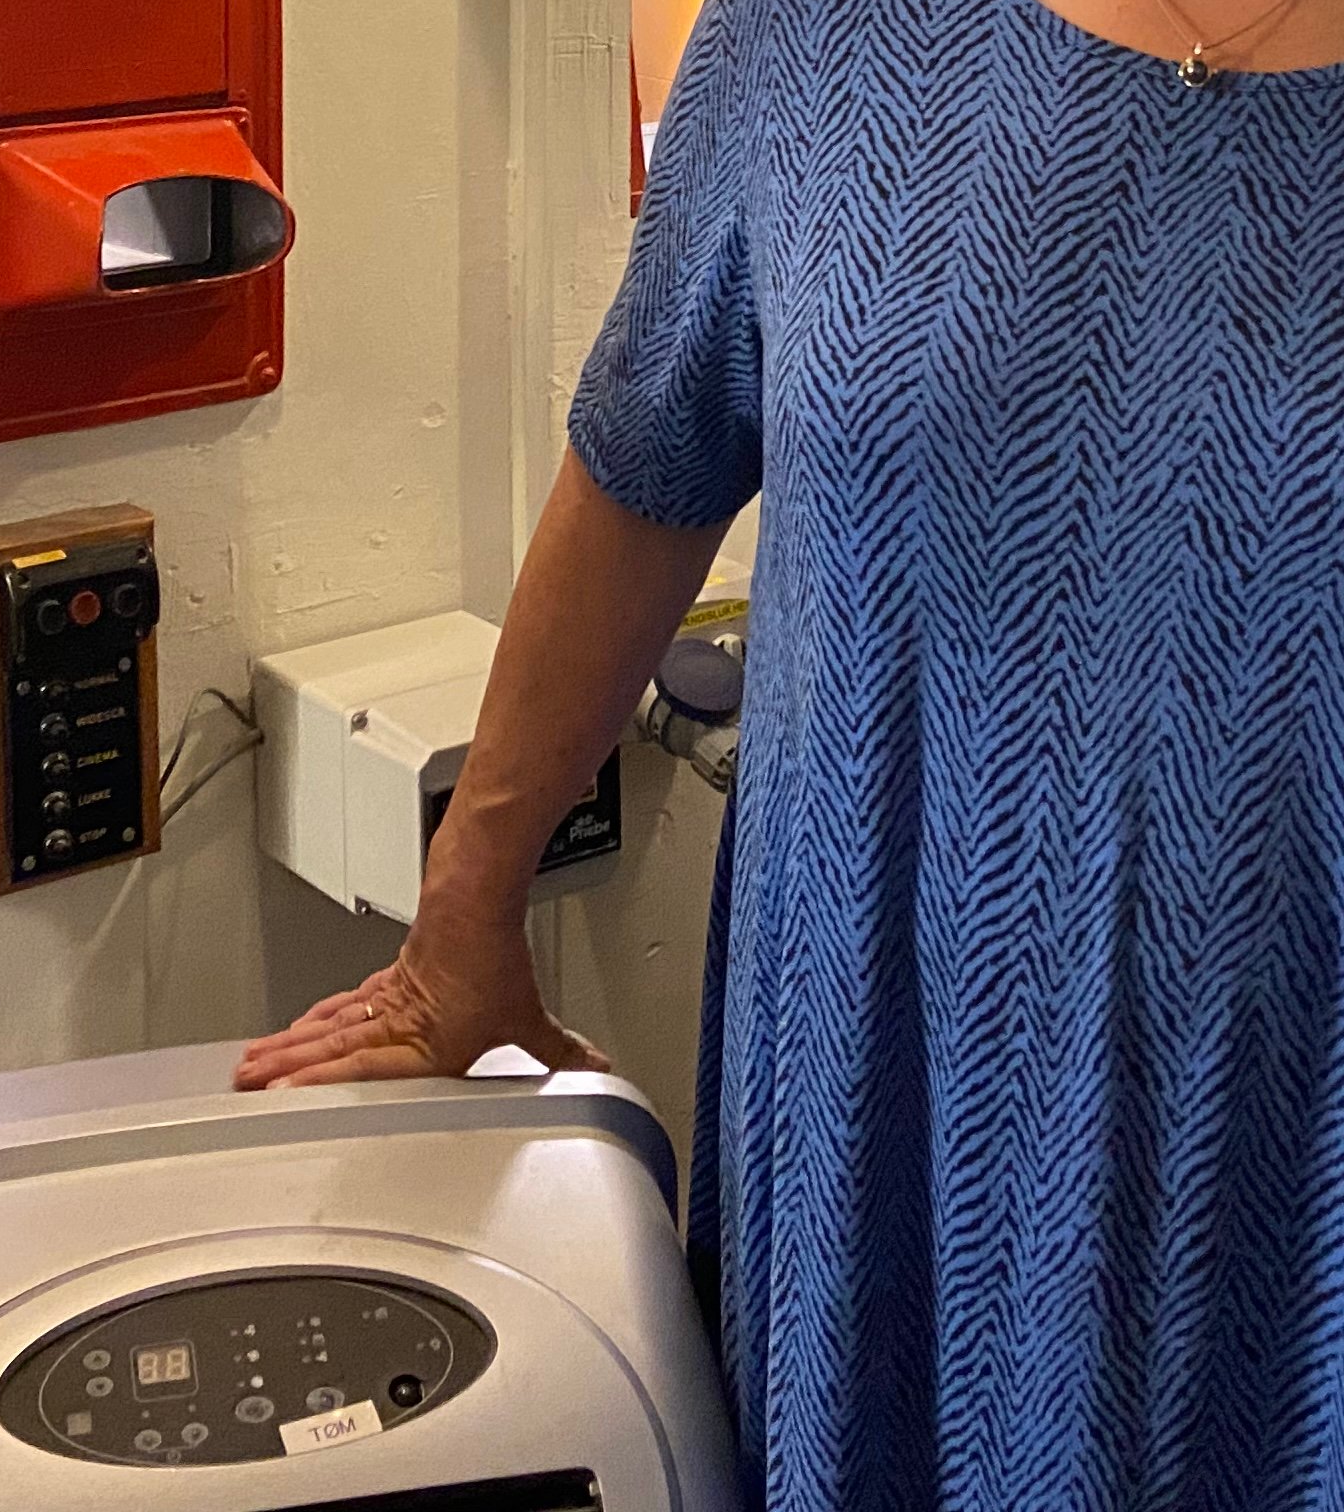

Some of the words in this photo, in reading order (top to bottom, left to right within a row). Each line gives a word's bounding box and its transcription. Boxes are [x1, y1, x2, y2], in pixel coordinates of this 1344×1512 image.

[77, 749, 120, 769] CINEMA
[79, 826, 108, 844] STOP
[308, 1417, 357, 1442] TØM
